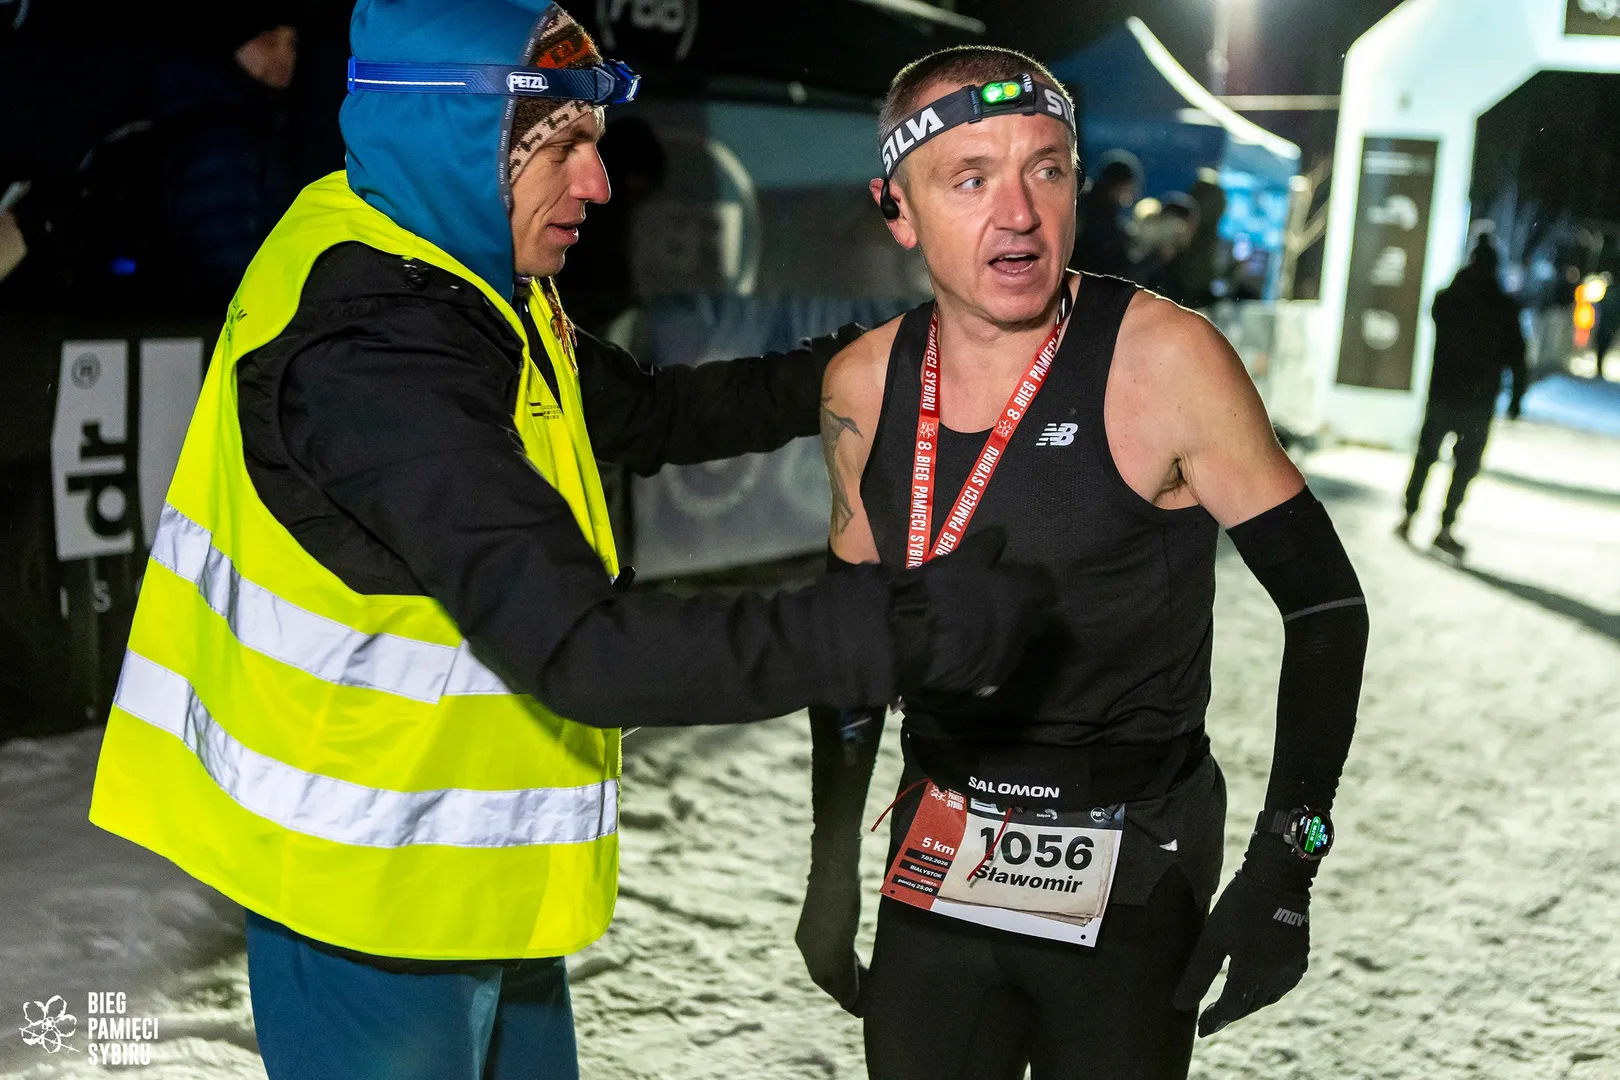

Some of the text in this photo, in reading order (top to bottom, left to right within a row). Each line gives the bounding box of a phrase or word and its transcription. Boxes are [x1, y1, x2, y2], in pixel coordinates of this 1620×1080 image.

[509, 75, 549, 93] PETZL
[882, 107, 945, 176] SILVA
[922, 372, 937, 411] SYBIRU
[948, 486, 980, 531] PAMIĘCI
[971, 446, 1000, 487] SYBIRU
[910, 486, 928, 531] PAMIĘCI
[908, 535, 925, 567] SYBIR
[968, 776, 1060, 798] SALOMON
[921, 837, 955, 856] 5 km
[980, 827, 1095, 870] 1056
[916, 882, 934, 893] 25:00
[973, 865, 1083, 894] Sławomir
